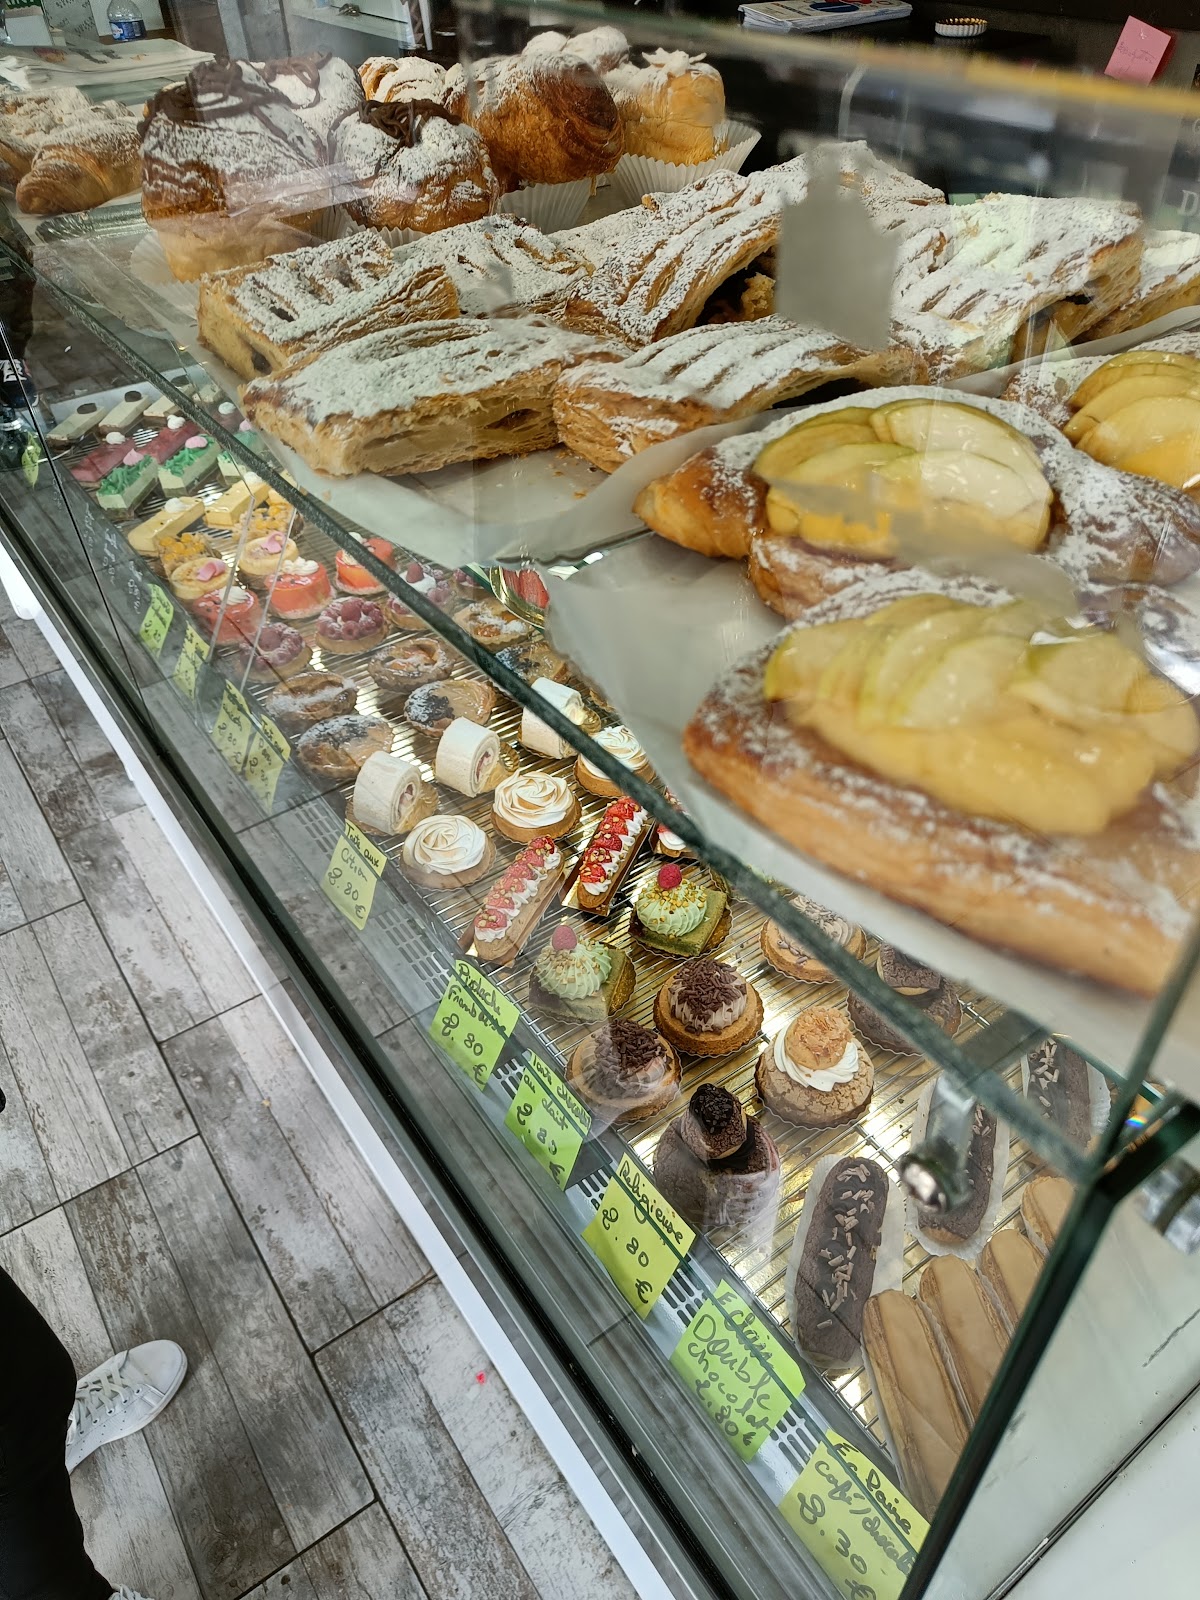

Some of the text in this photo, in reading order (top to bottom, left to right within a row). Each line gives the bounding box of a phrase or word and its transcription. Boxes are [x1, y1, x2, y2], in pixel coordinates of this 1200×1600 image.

[363, 848, 380, 868] aux
[355, 904, 367, 920] €
[441, 1012, 488, 1086] 2.80 €
[619, 1160, 684, 1245] Religieuse
[601, 1206, 654, 1304] 2.80 €
